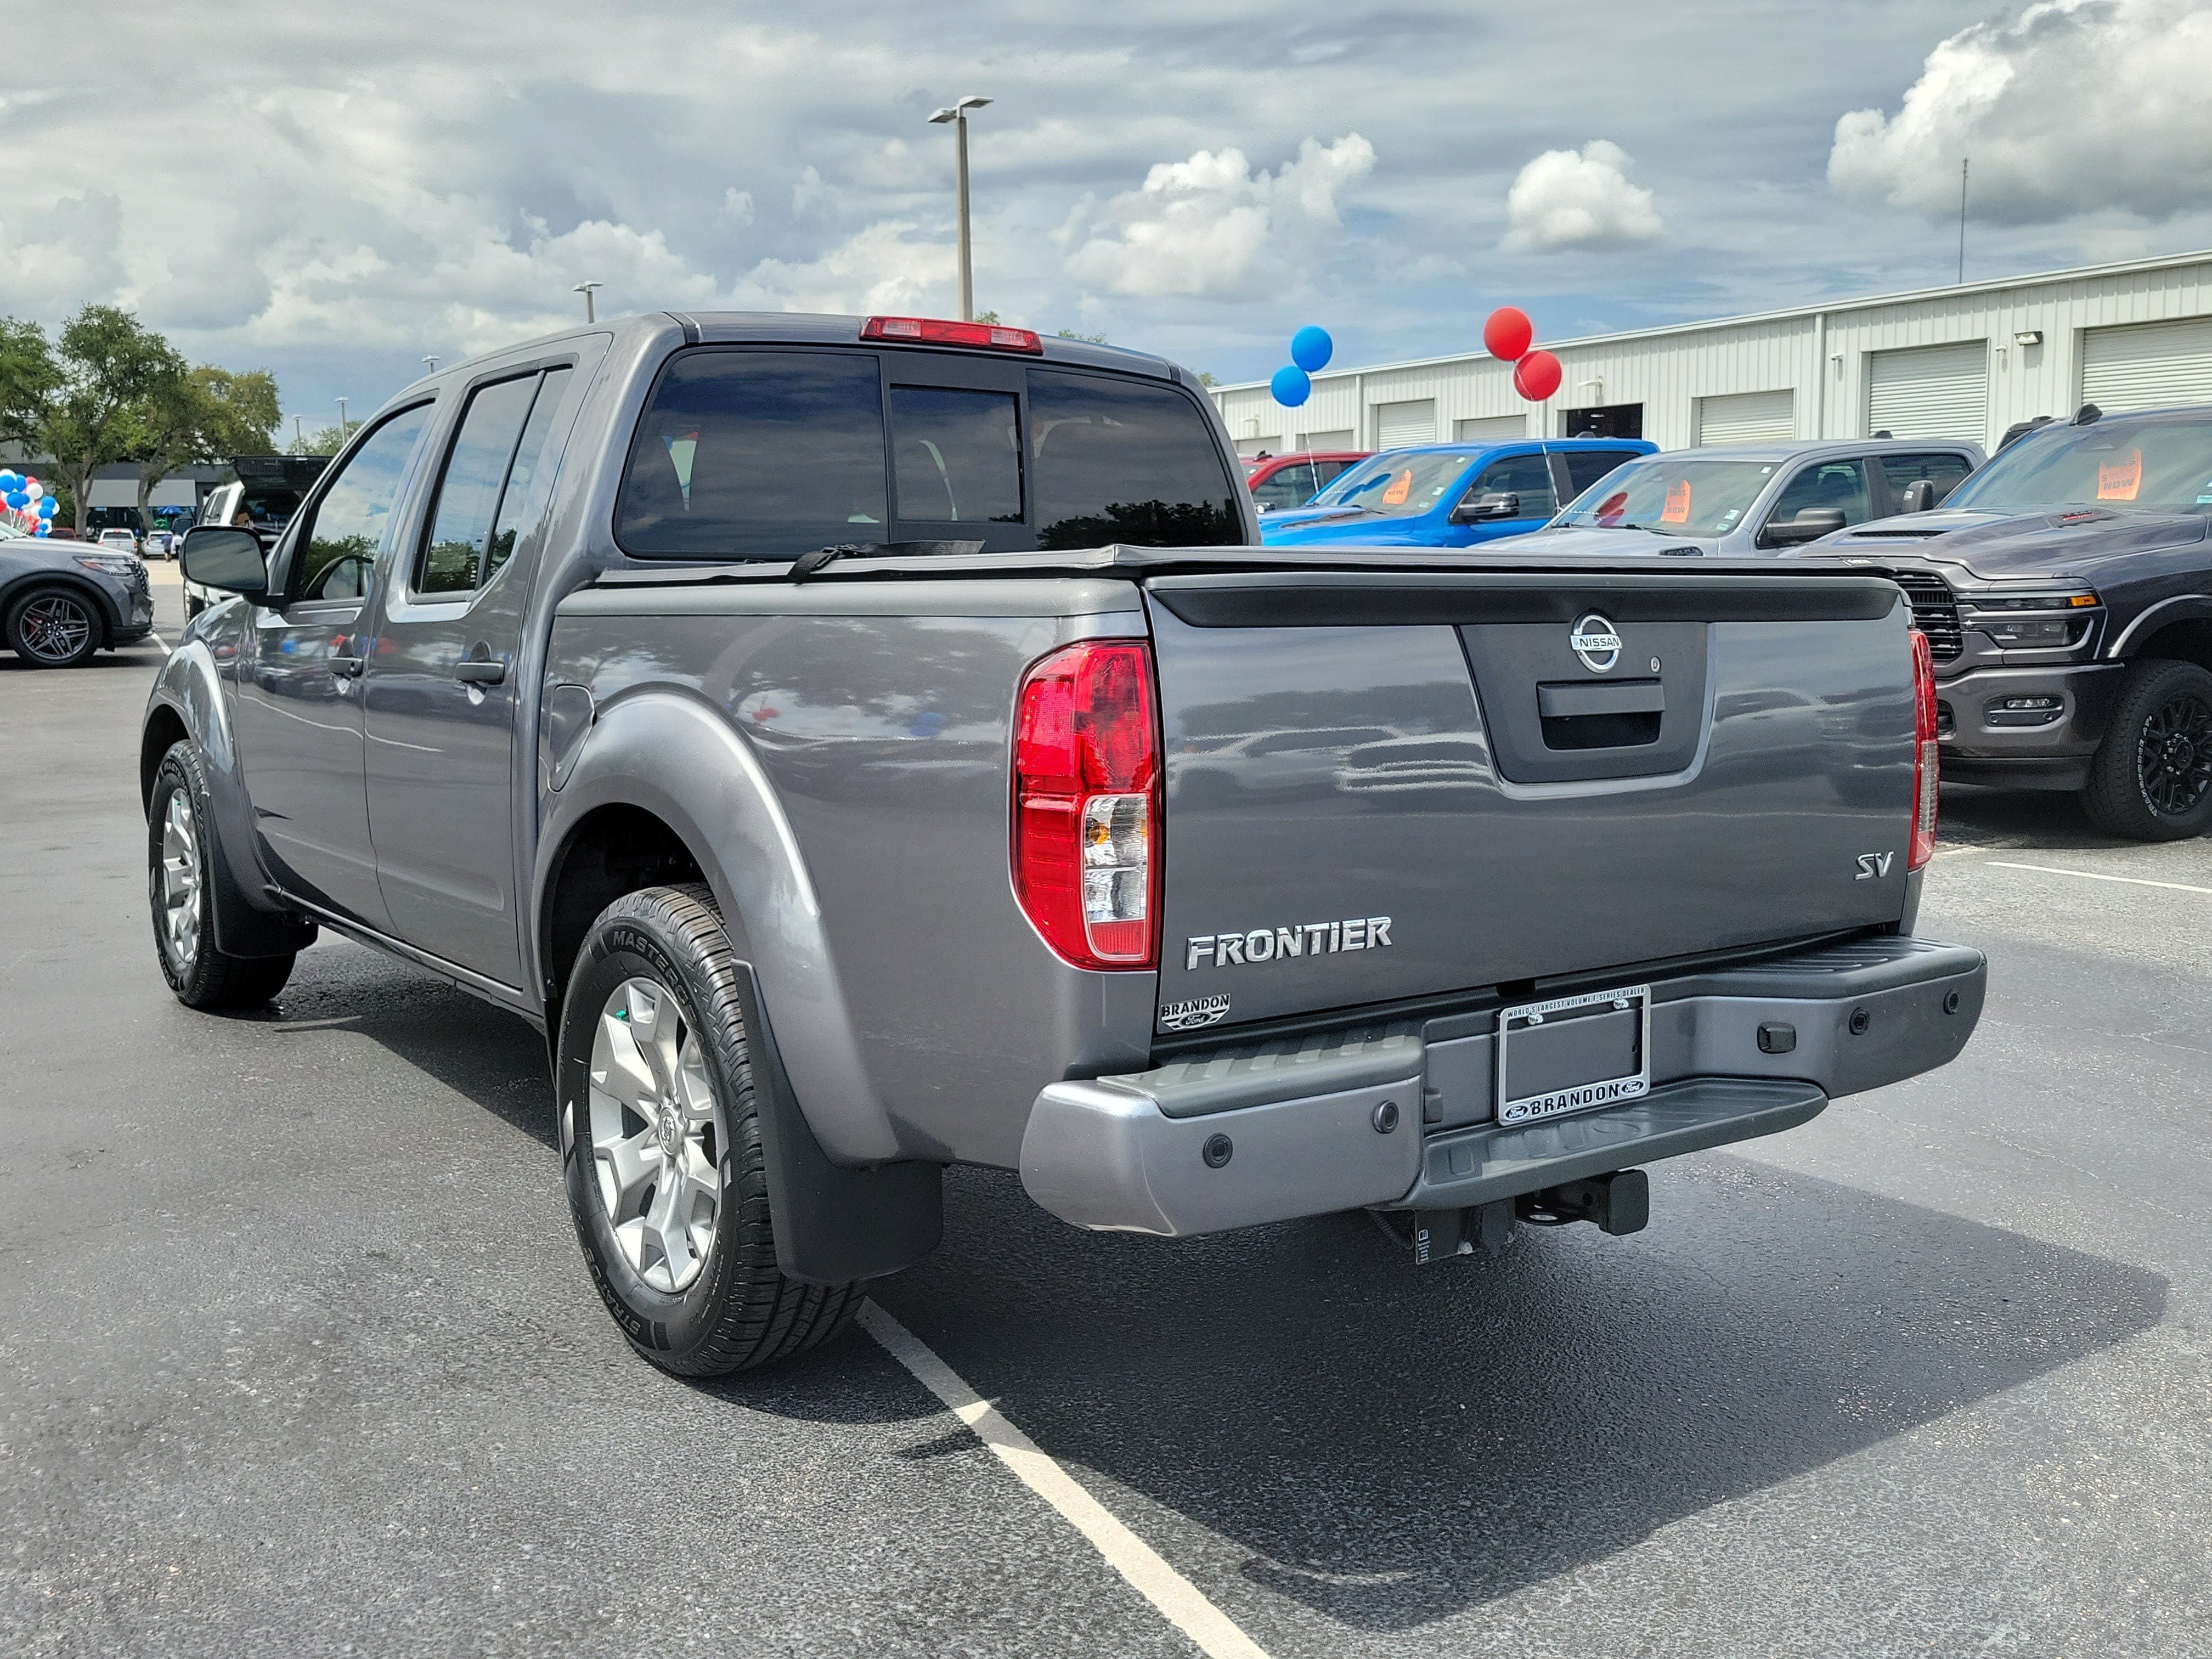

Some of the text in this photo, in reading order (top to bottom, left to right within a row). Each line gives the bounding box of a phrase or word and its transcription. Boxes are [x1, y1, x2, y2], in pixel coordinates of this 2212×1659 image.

[2103, 478, 2134, 490] NOW
[1579, 637, 1619, 647] NISSAN
[1854, 850, 1894, 881] SV
[1185, 916, 1392, 971] FRONTIER
[1161, 994, 1229, 1017] BRANDON
[1507, 987, 1645, 1018] WORLD'S LARGEST VOLUME F-SERIES DEALER
[1185, 1013, 1206, 1025] Ford
[1508, 1081, 1642, 1118] Ford BRANDON Ford
